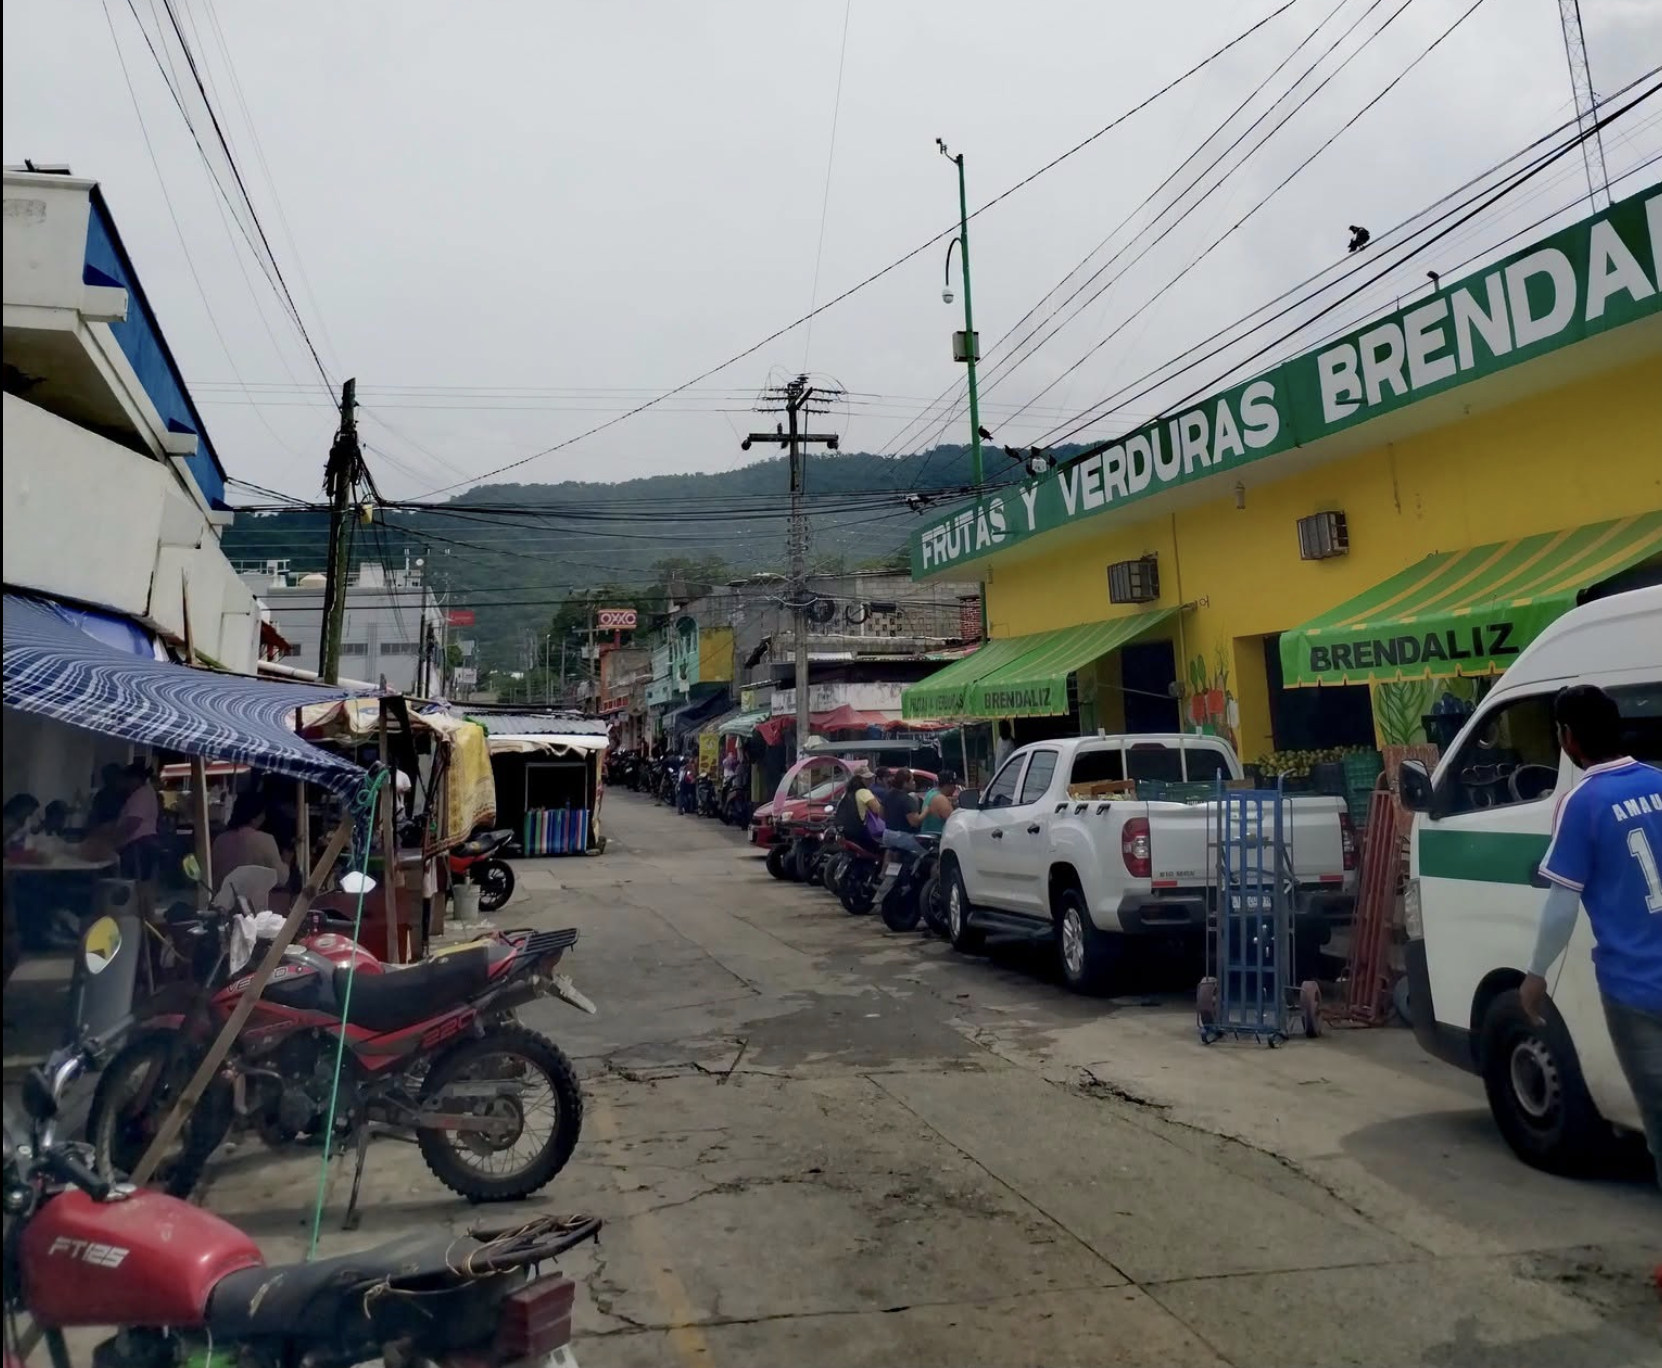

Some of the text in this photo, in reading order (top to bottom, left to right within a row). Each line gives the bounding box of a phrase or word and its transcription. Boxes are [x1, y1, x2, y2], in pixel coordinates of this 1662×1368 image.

[921, 498, 1005, 570] FRUTAS
[1020, 481, 1038, 531] Y
[1058, 380, 1280, 516] VERDURAS
[600, 612, 636, 625] OXXO
[1310, 622, 1519, 673] BRENDALIZ
[984, 687, 1051, 710] BRENDALIZ
[227, 966, 289, 993] VEO
[48, 1236, 130, 1268] FT125
